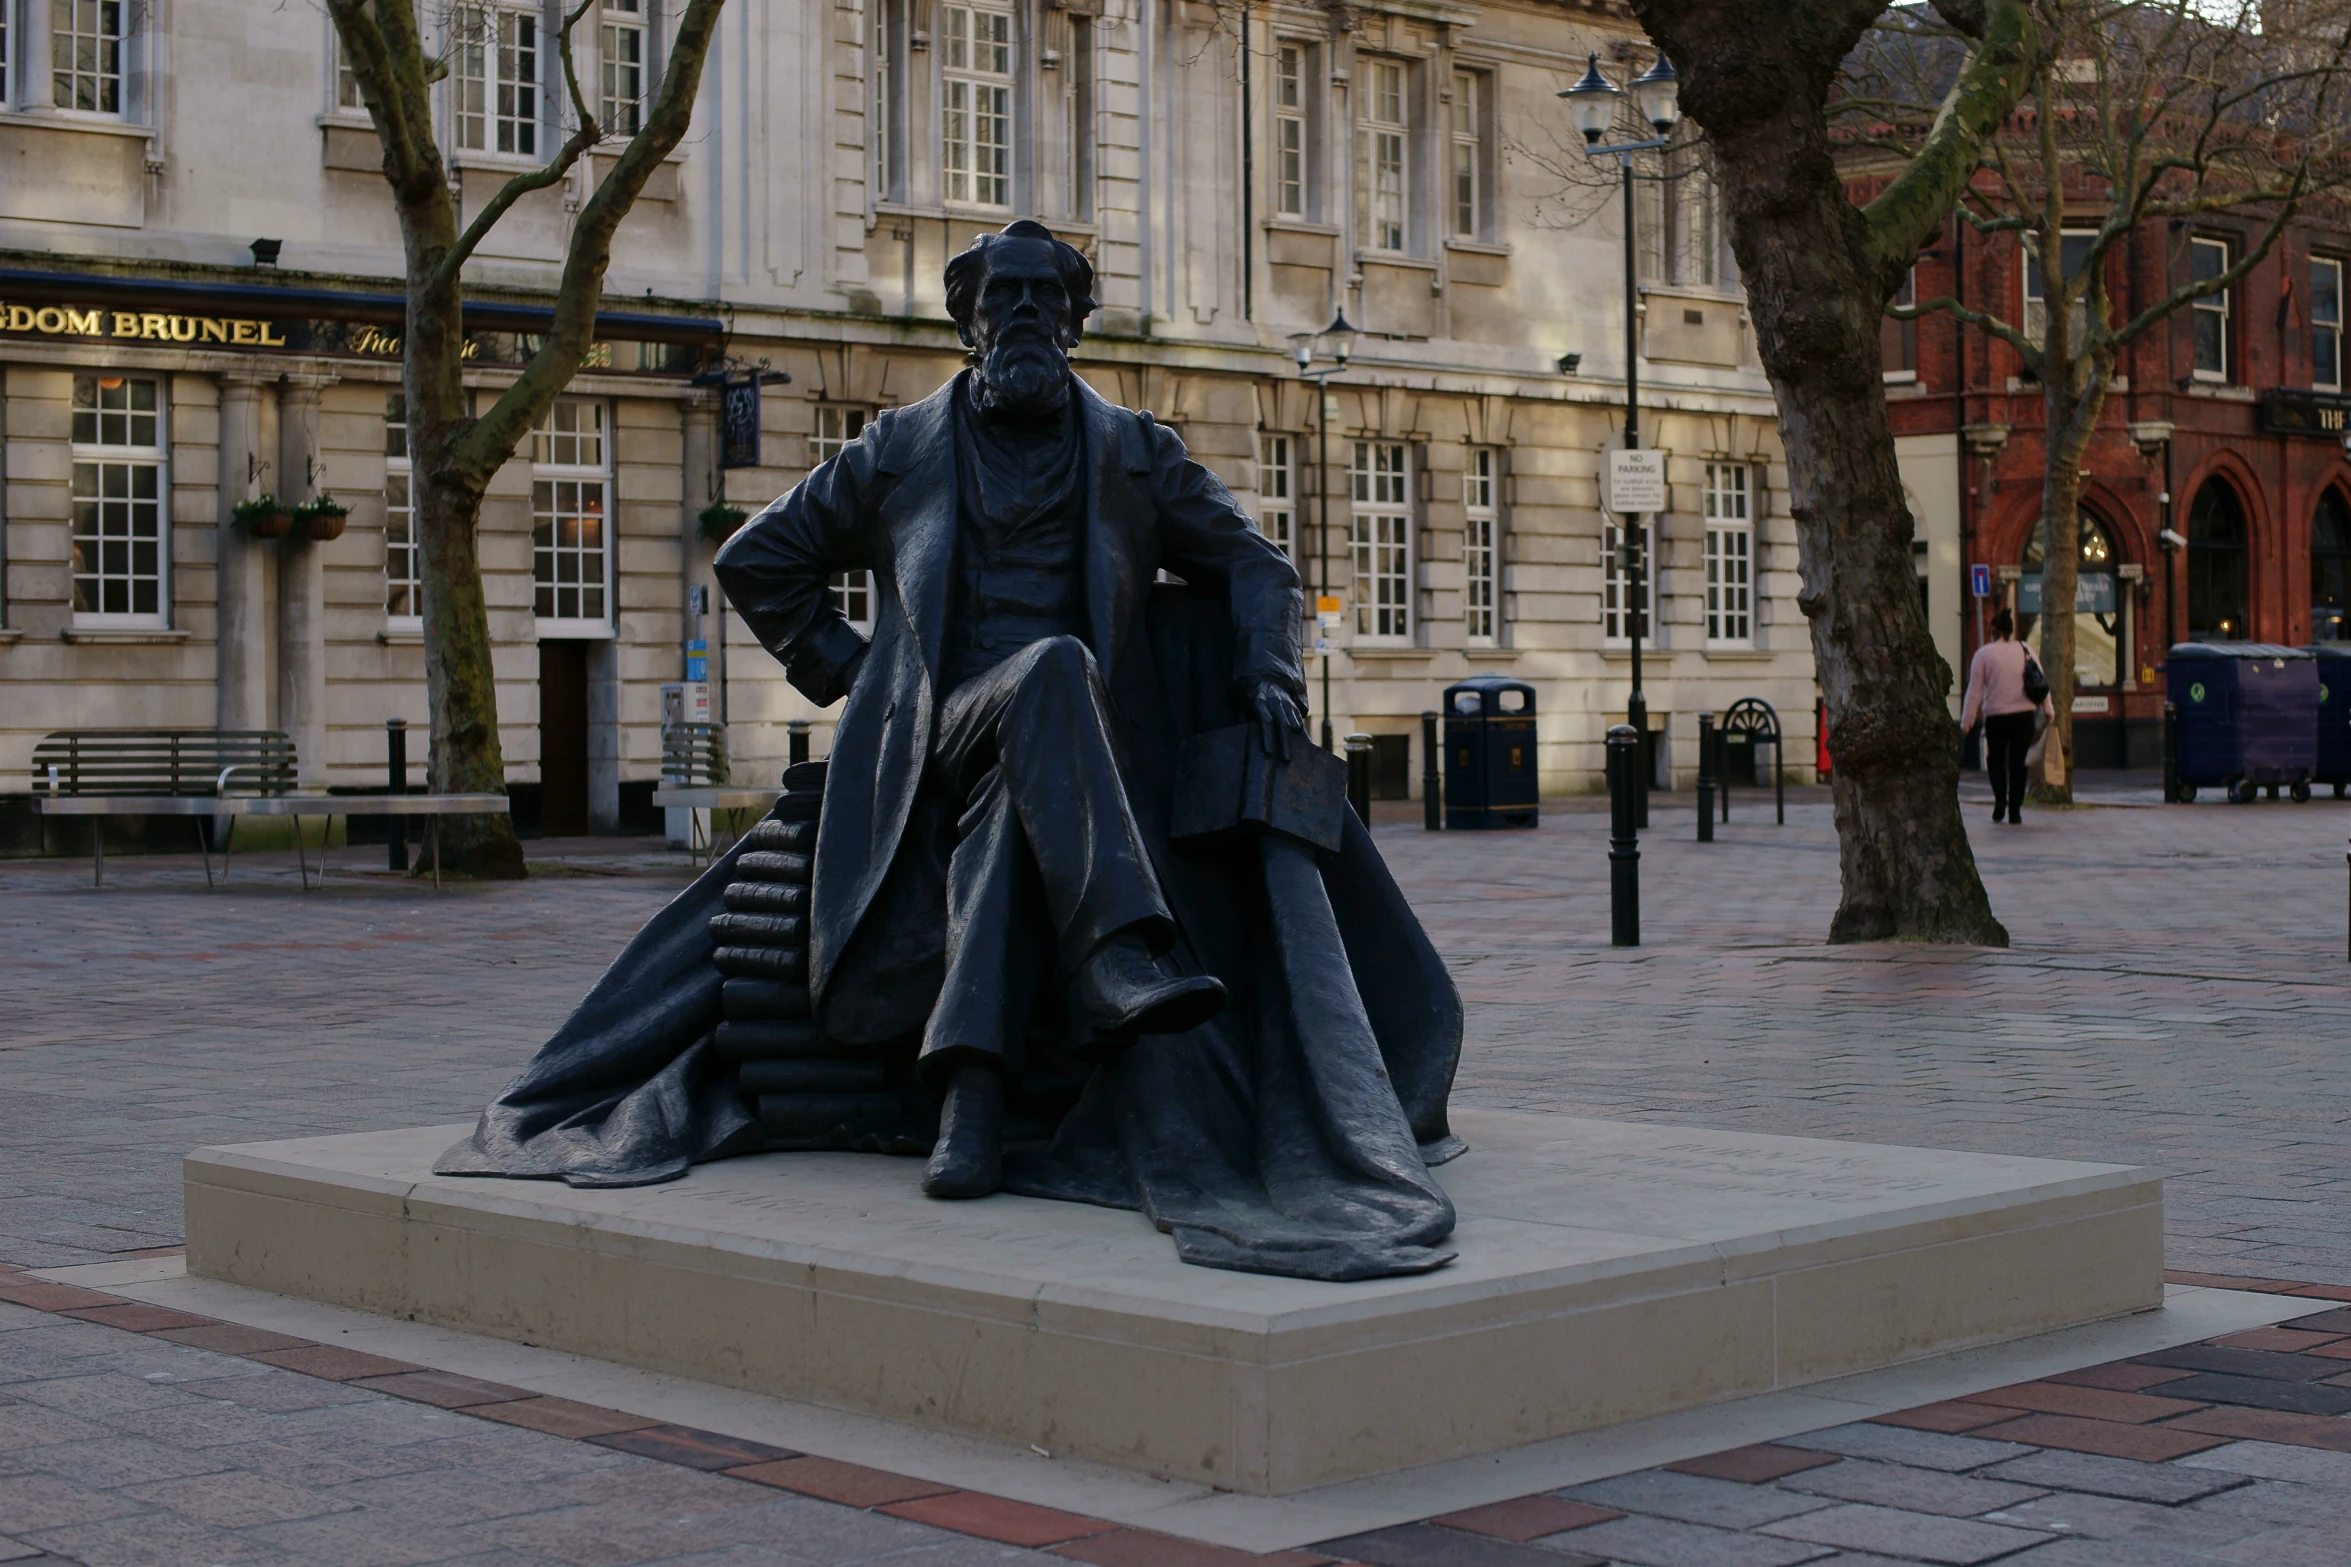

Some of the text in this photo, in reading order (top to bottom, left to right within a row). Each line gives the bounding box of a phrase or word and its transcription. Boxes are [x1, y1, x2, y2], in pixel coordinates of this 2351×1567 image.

[111, 311, 286, 347] BRUNEL
[348, 324, 401, 356] Free
[1617, 464, 1656, 474] PARKING
[1629, 454, 1643, 463] NO
